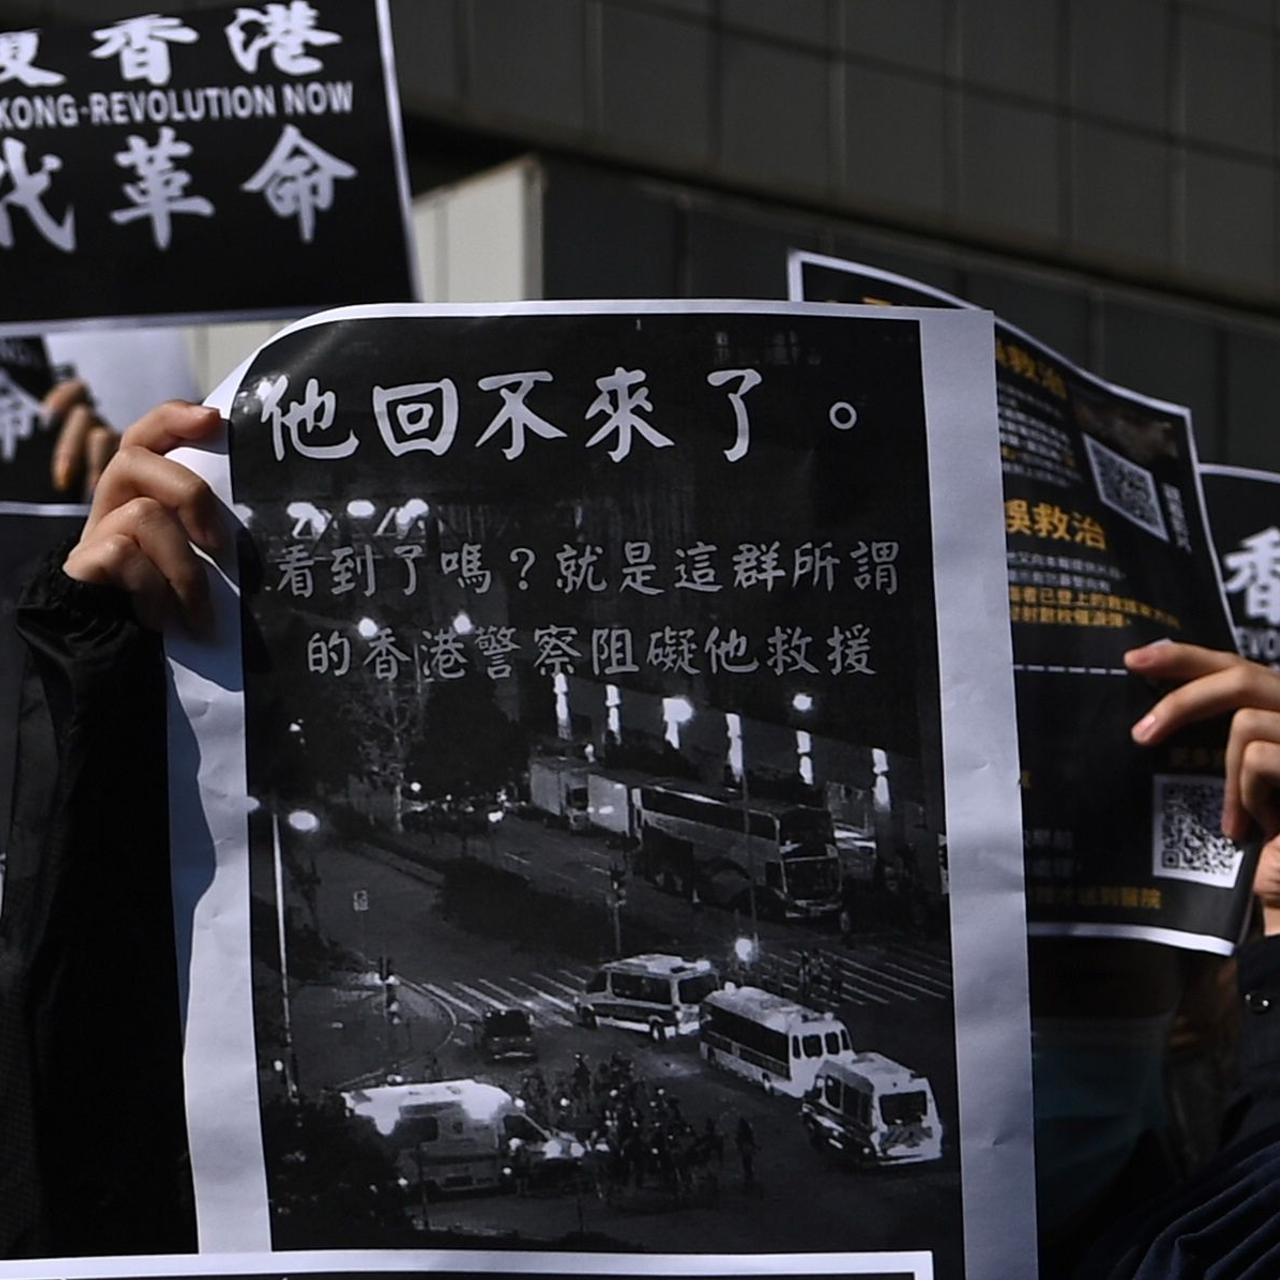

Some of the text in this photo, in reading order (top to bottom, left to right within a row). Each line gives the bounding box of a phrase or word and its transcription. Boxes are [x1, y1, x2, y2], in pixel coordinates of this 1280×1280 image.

[283, 81, 354, 115] NOW
[262, 366, 858, 463] 他回不來了。
[275, 540, 900, 598] 看到了嗎？就是這群所謂
[307, 623, 877, 682] 的香港警察阻礙他救援
